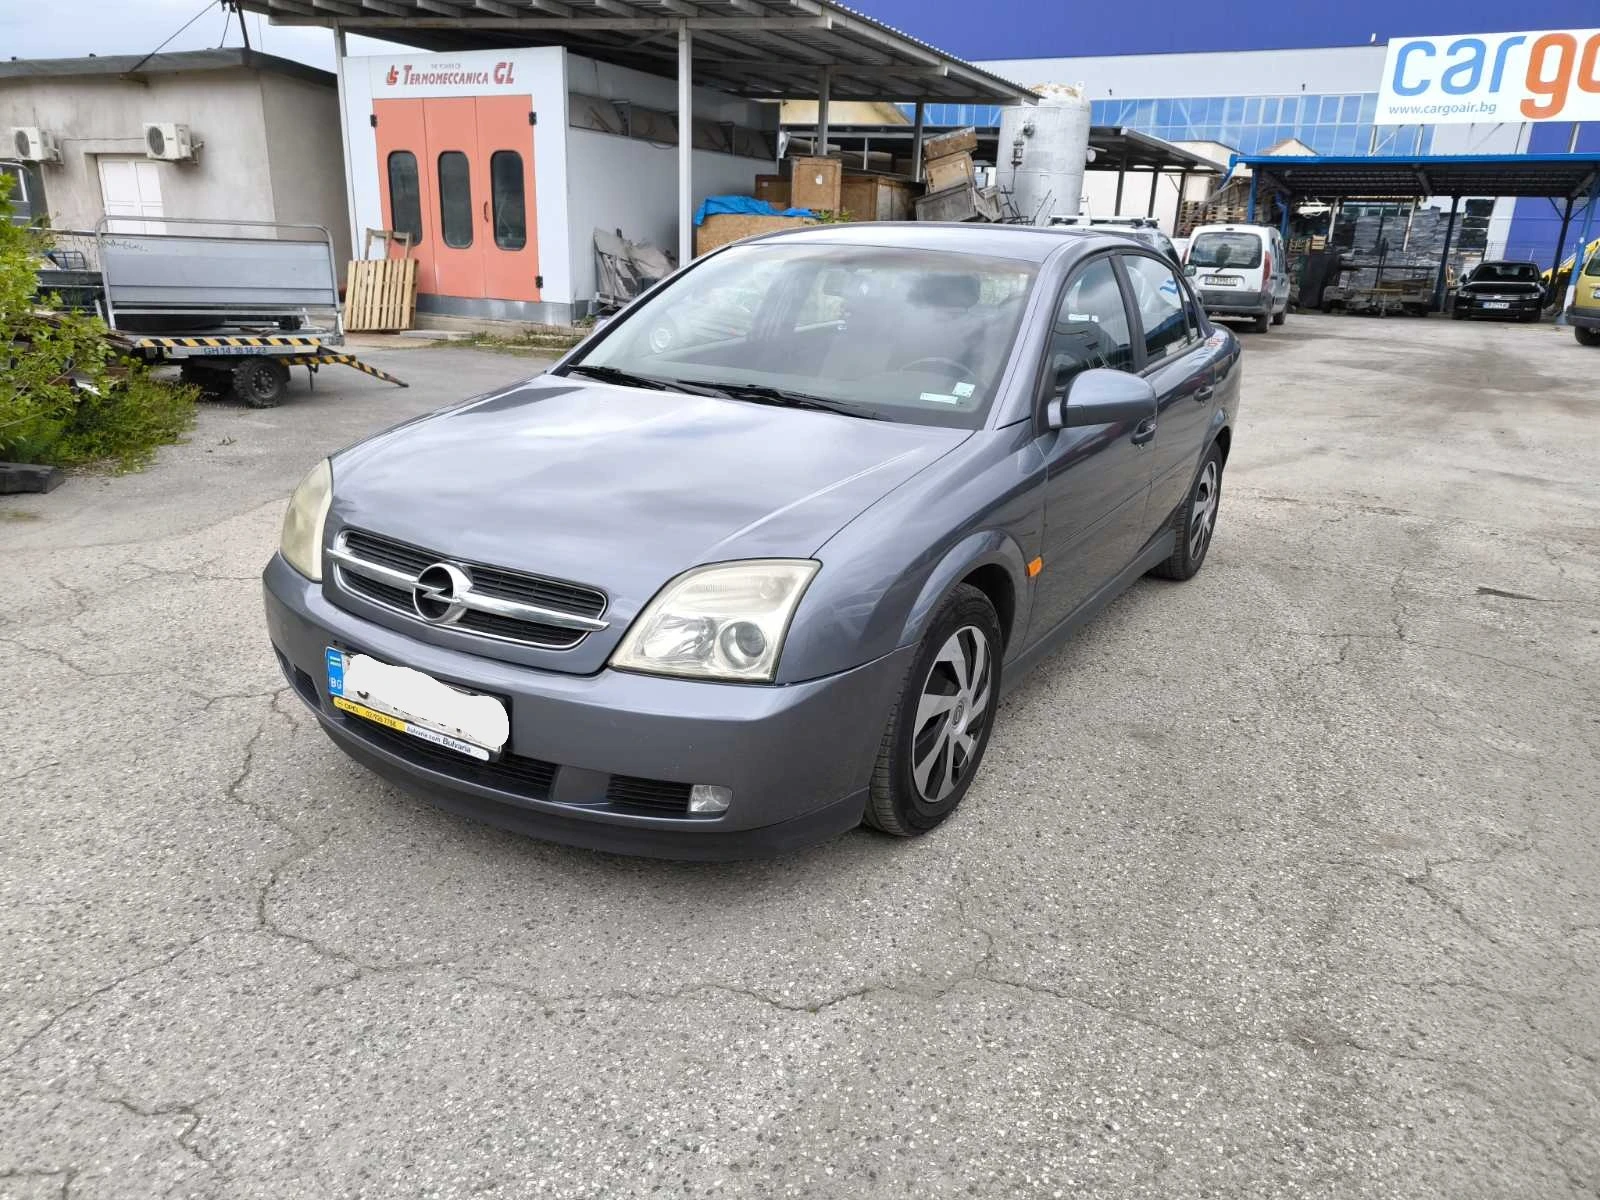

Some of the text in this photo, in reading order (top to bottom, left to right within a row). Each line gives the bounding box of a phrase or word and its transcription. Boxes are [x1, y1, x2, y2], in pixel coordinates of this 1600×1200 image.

[403, 62, 515, 85] TERMOMECCANICA GL
[1388, 101, 1497, 116] www.cargoair.bg
[330, 676, 342, 690] BG
[344, 702, 359, 713] OPEL
[442, 736, 472, 753] Bulvaria
